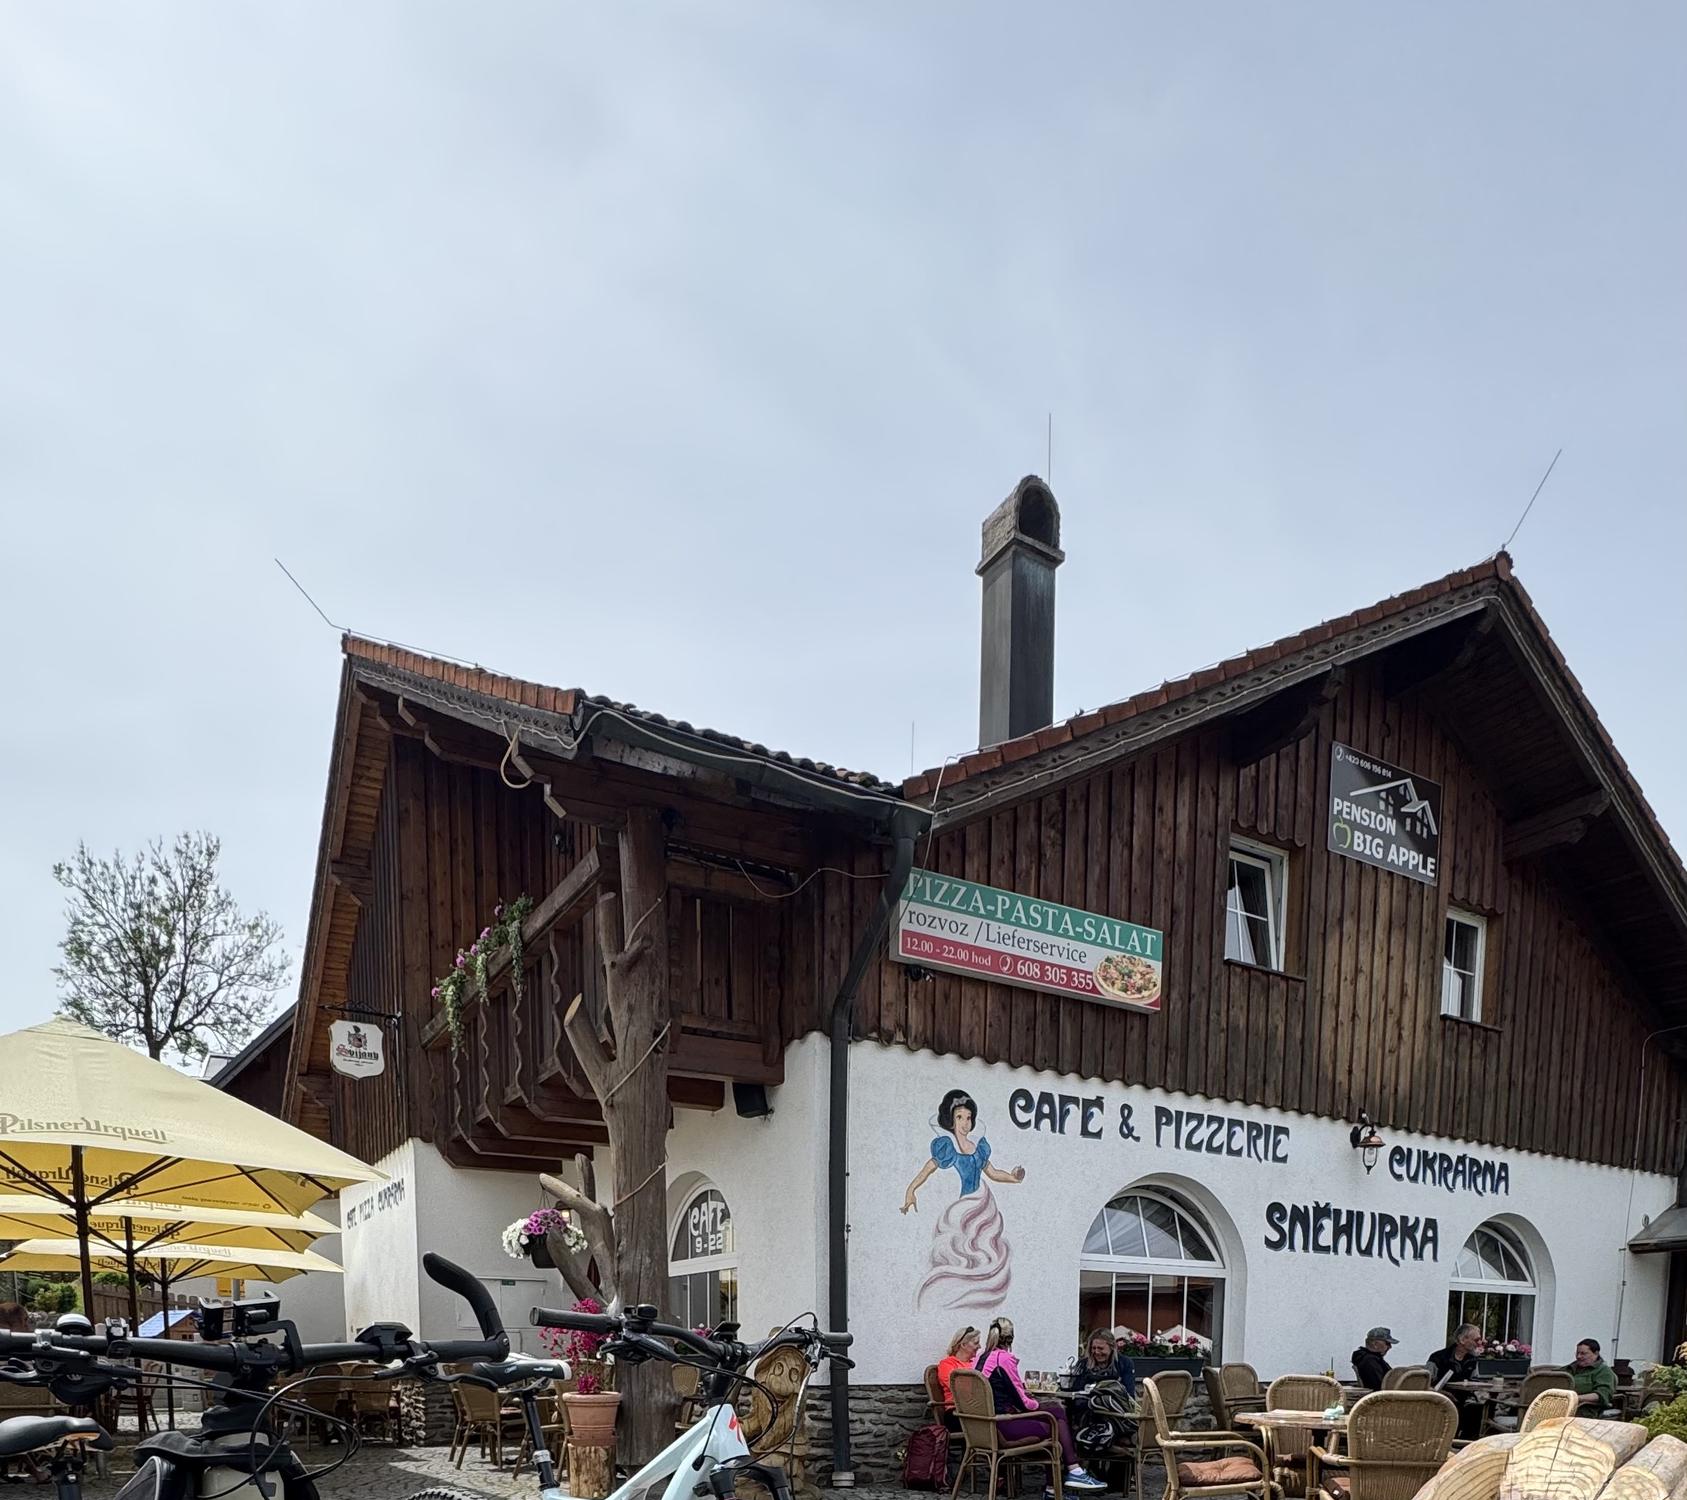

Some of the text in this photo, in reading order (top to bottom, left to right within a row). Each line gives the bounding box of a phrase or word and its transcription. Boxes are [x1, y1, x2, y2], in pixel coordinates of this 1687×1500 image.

[1333, 797, 1396, 836] PENSION
[1353, 830, 1436, 878] BIG APPLE
[908, 872, 1157, 956] PIZZA-PASTA-SALAT
[908, 907, 969, 937] rozvoz
[906, 937, 934, 954] 12.00
[942, 945, 970, 961] 22.00
[971, 951, 992, 967] hod
[1017, 959, 1041, 979] 608
[1044, 964, 1067, 985] 305
[1070, 970, 1093, 991] 355
[0, 1113, 167, 1141] Pilsner Urquell
[1118, 1103, 1141, 1142] &
[1155, 1105, 1290, 1164] PIZZERIE
[1388, 1145, 1510, 1197] CUKRÁRNA
[1265, 1201, 1439, 1266] SNĚHURKA
